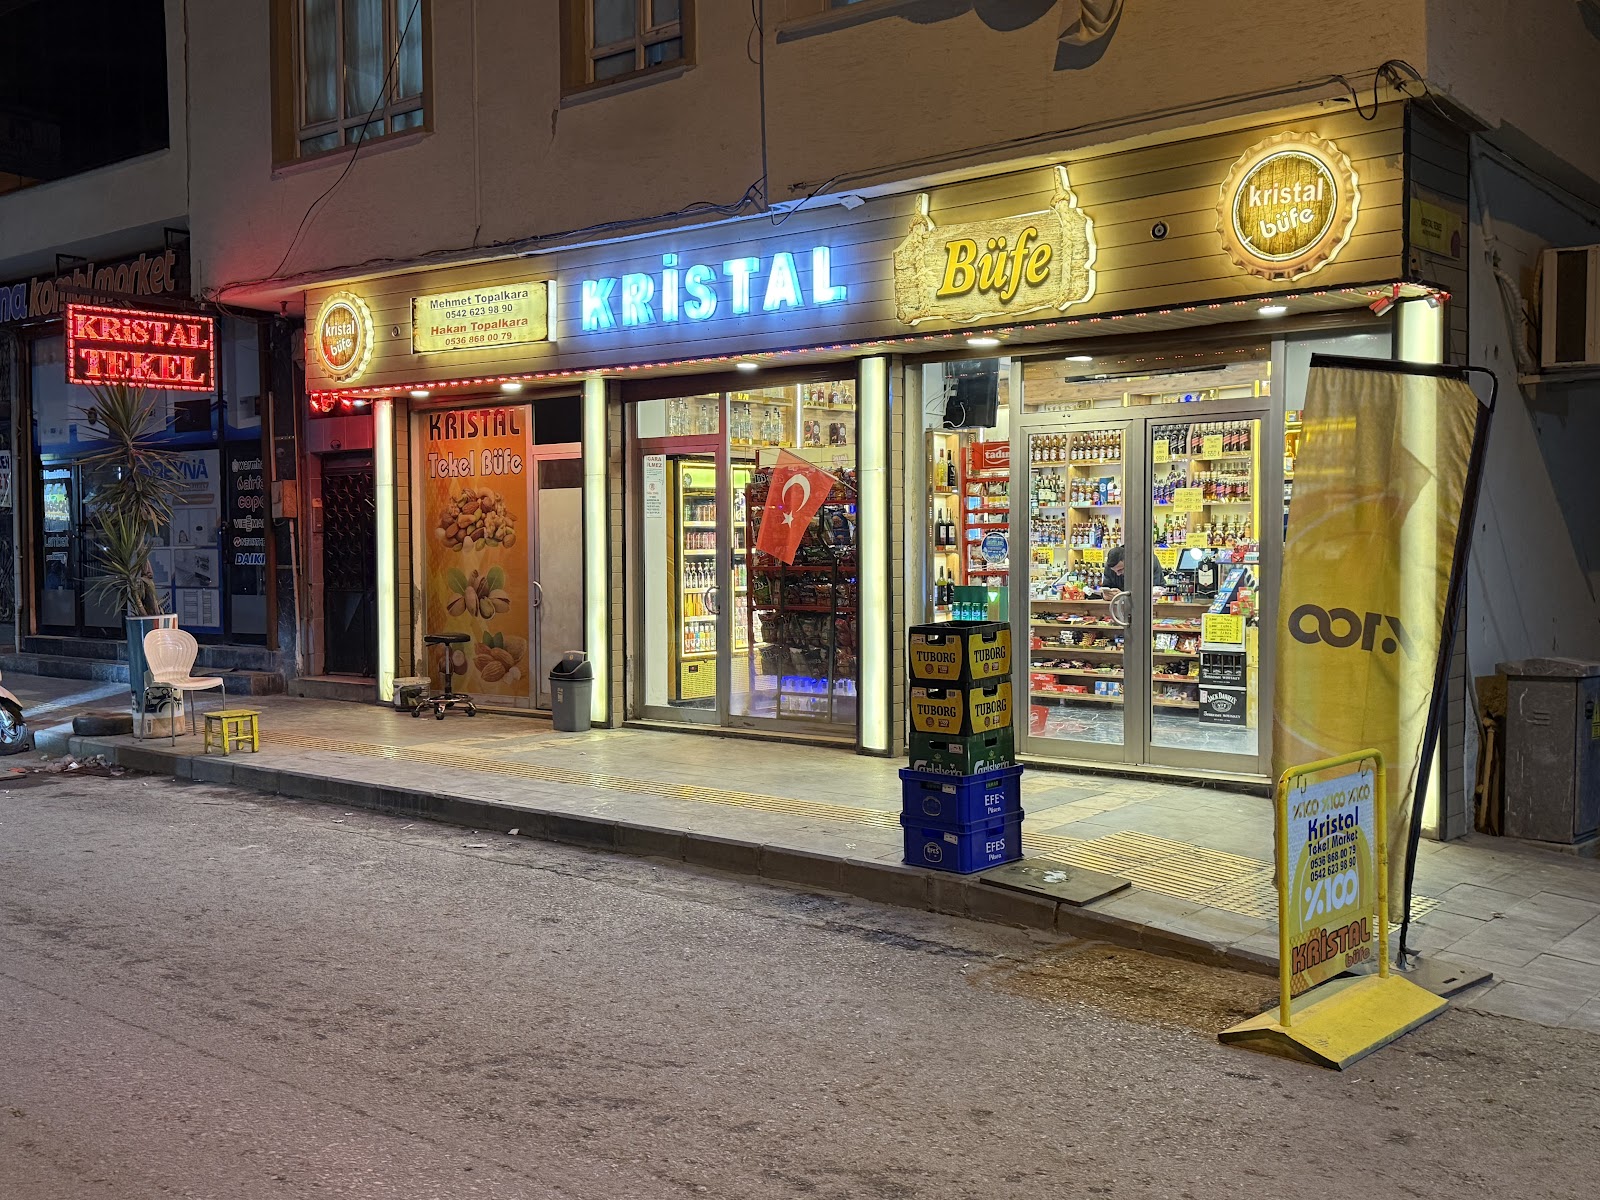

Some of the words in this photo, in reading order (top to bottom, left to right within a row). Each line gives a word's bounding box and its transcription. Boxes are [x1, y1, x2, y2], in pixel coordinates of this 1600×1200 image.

[1249, 177, 1324, 207] kristal
[1259, 206, 1315, 239] büfe
[95, 250, 176, 302] market
[937, 228, 1053, 303] Büfe
[430, 296, 473, 310] Mehmet
[475, 289, 529, 306] Topalkara
[445, 309, 467, 319] 0542
[469, 306, 486, 317] 623
[488, 305, 499, 315] 98
[501, 303, 513, 313] 90
[325, 322, 355, 337] kristal
[430, 323, 467, 336] Hakan
[470, 317, 529, 332] Topalkara
[330, 338, 353, 357] büfe
[445, 336, 467, 346] 0536
[469, 334, 486, 344] 868
[487, 333, 499, 342] 00
[501, 331, 513, 341] 79
[80, 348, 206, 383] TEKEL
[428, 449, 475, 478] Tekel
[481, 447, 523, 476] Büfe
[917, 651, 956, 663] TUBORG
[974, 646, 1006, 663] TUBORG
[917, 704, 956, 718] TUBORG
[975, 699, 1006, 717] TUBORG
[1308, 806, 1358, 841] Kristal
[986, 839, 1005, 853] EFES
[1308, 837, 1330, 857] Tekel
[1331, 830, 1358, 849] Market
[1310, 856, 1326, 870] 0536
[1348, 844, 1356, 855] 79
[1310, 868, 1326, 882] 0542
[1327, 863, 1338, 876] 623
[1340, 859, 1347, 871] 98
[1349, 856, 1356, 867] 90
[1304, 869, 1358, 921] %100
[1344, 946, 1370, 968] büfe
